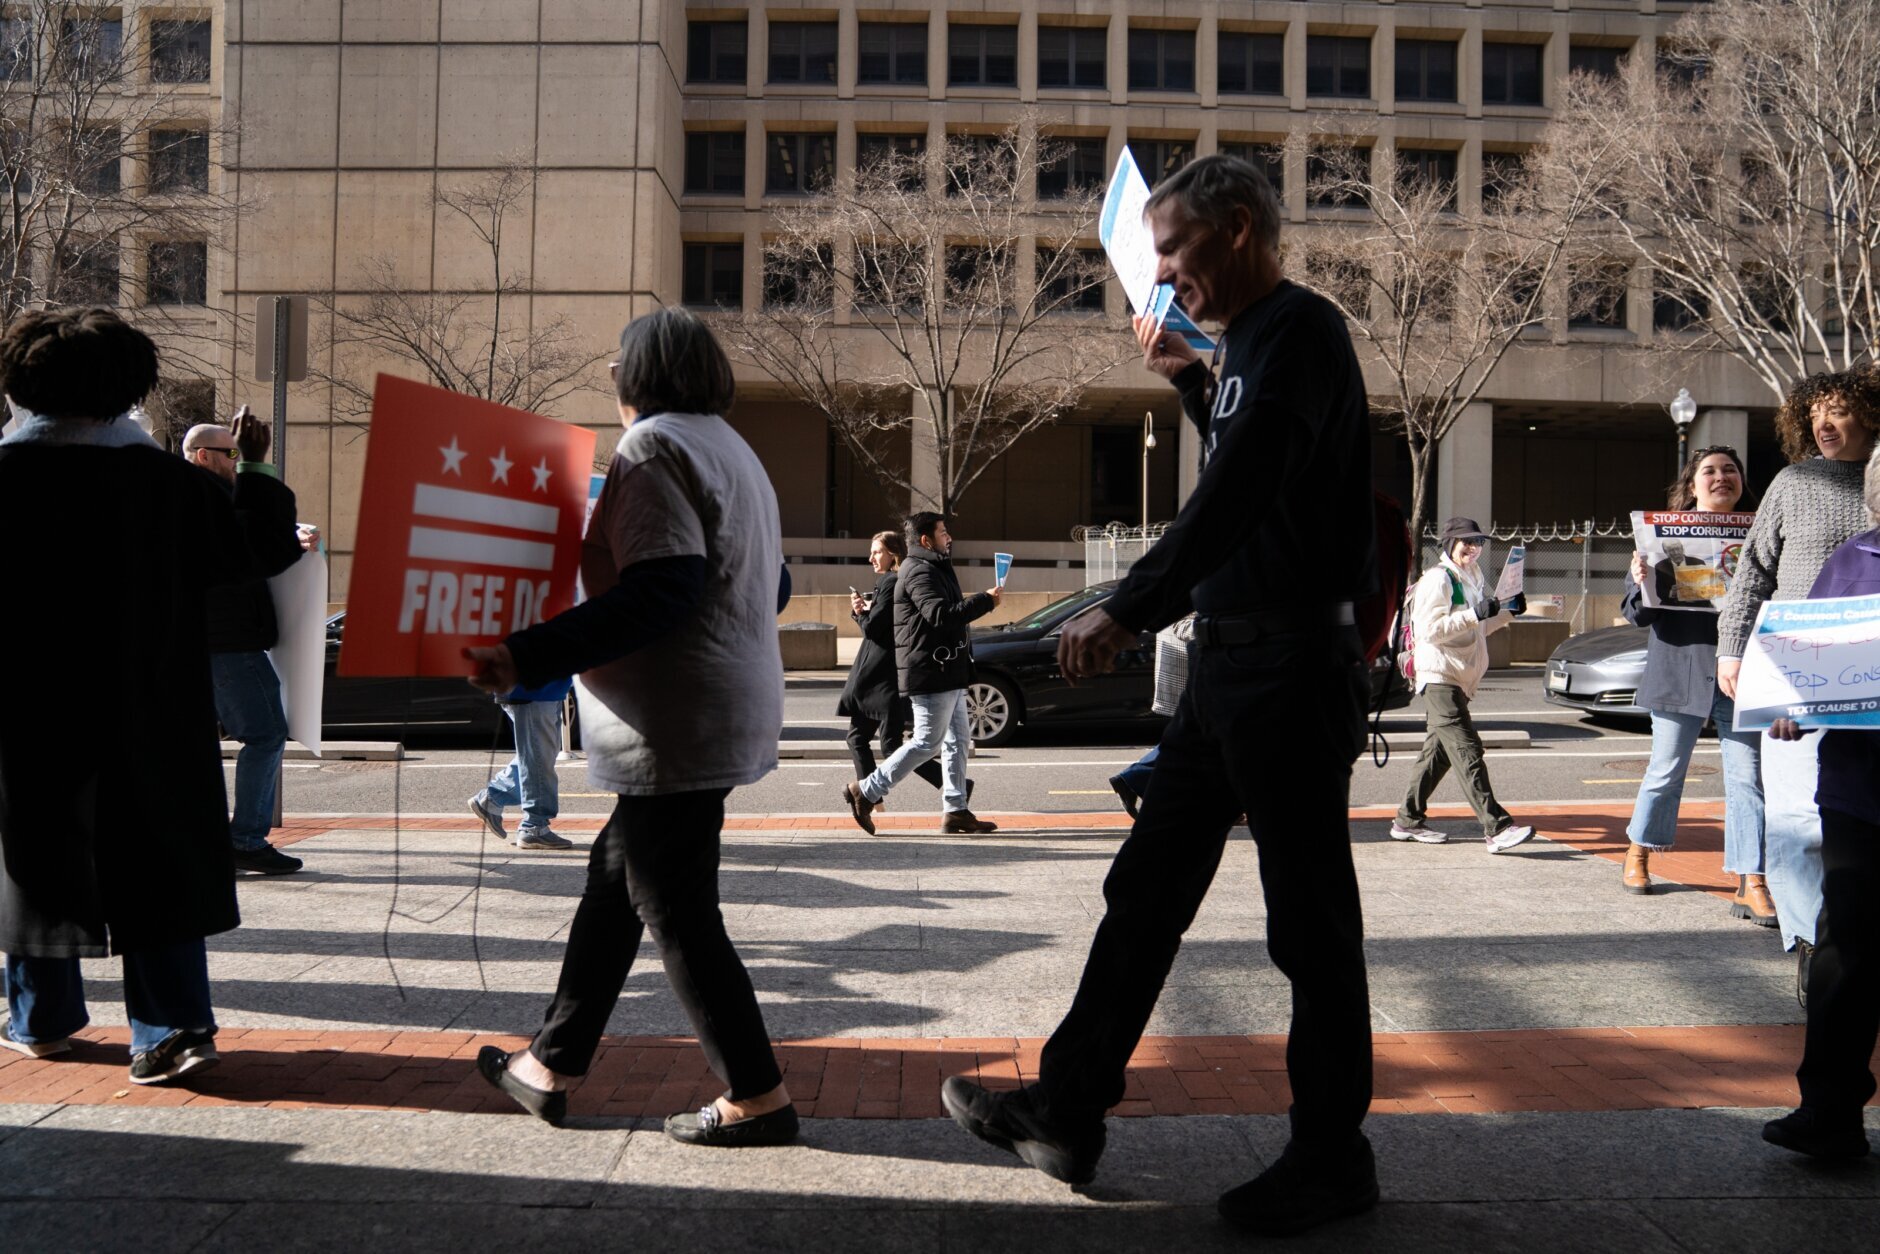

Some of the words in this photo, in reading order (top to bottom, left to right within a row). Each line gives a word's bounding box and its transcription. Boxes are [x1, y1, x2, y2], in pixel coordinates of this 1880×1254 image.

[1652, 513, 1680, 524] STOP
[1661, 525, 1689, 536] STOP
[1690, 526, 1750, 537] CORRUPTIO
[398, 569, 505, 636] FREE
[511, 579, 551, 633] DC
[1784, 611, 1841, 621] Common
[1787, 704, 1816, 716] TEXT
[1817, 702, 1858, 713] CAUSE
[1860, 701, 1877, 711] TO
